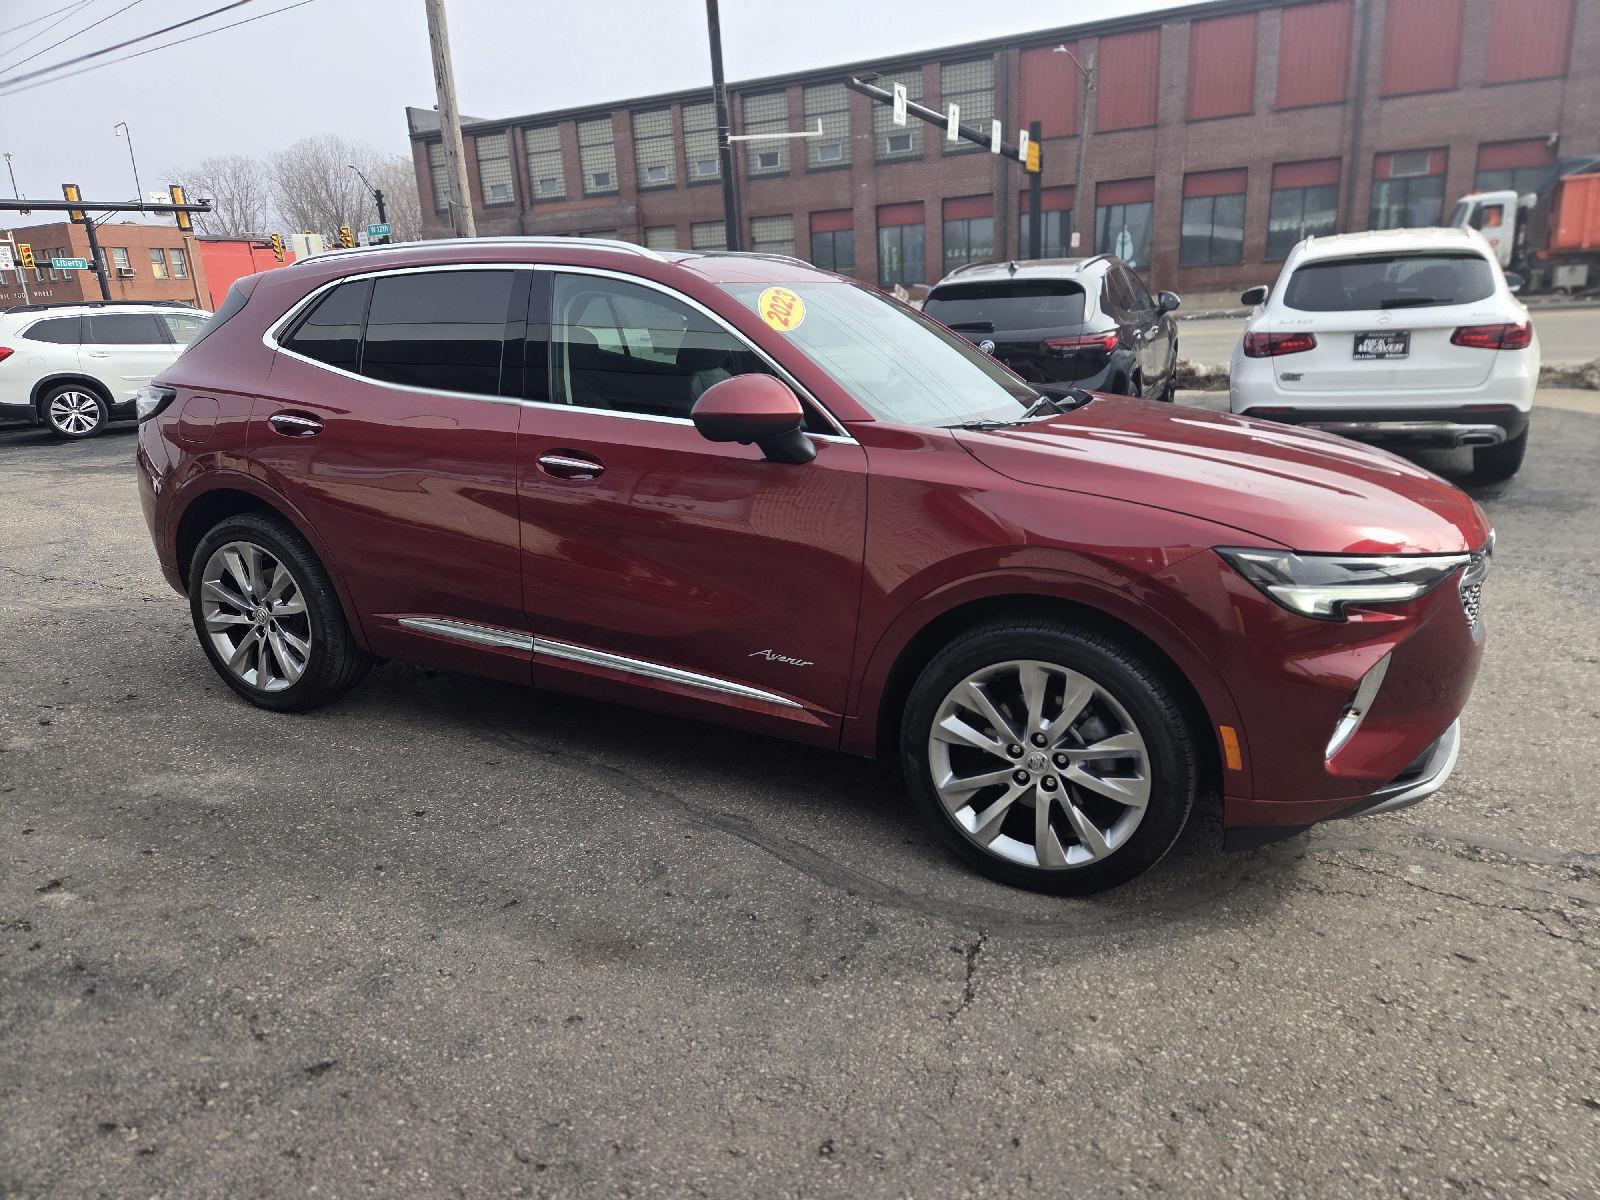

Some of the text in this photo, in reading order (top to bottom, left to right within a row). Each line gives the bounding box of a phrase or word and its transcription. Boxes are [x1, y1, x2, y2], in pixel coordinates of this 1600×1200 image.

[55, 259, 83, 268] Liberty
[766, 289, 797, 328] 2023
[748, 649, 814, 667] Avenir
